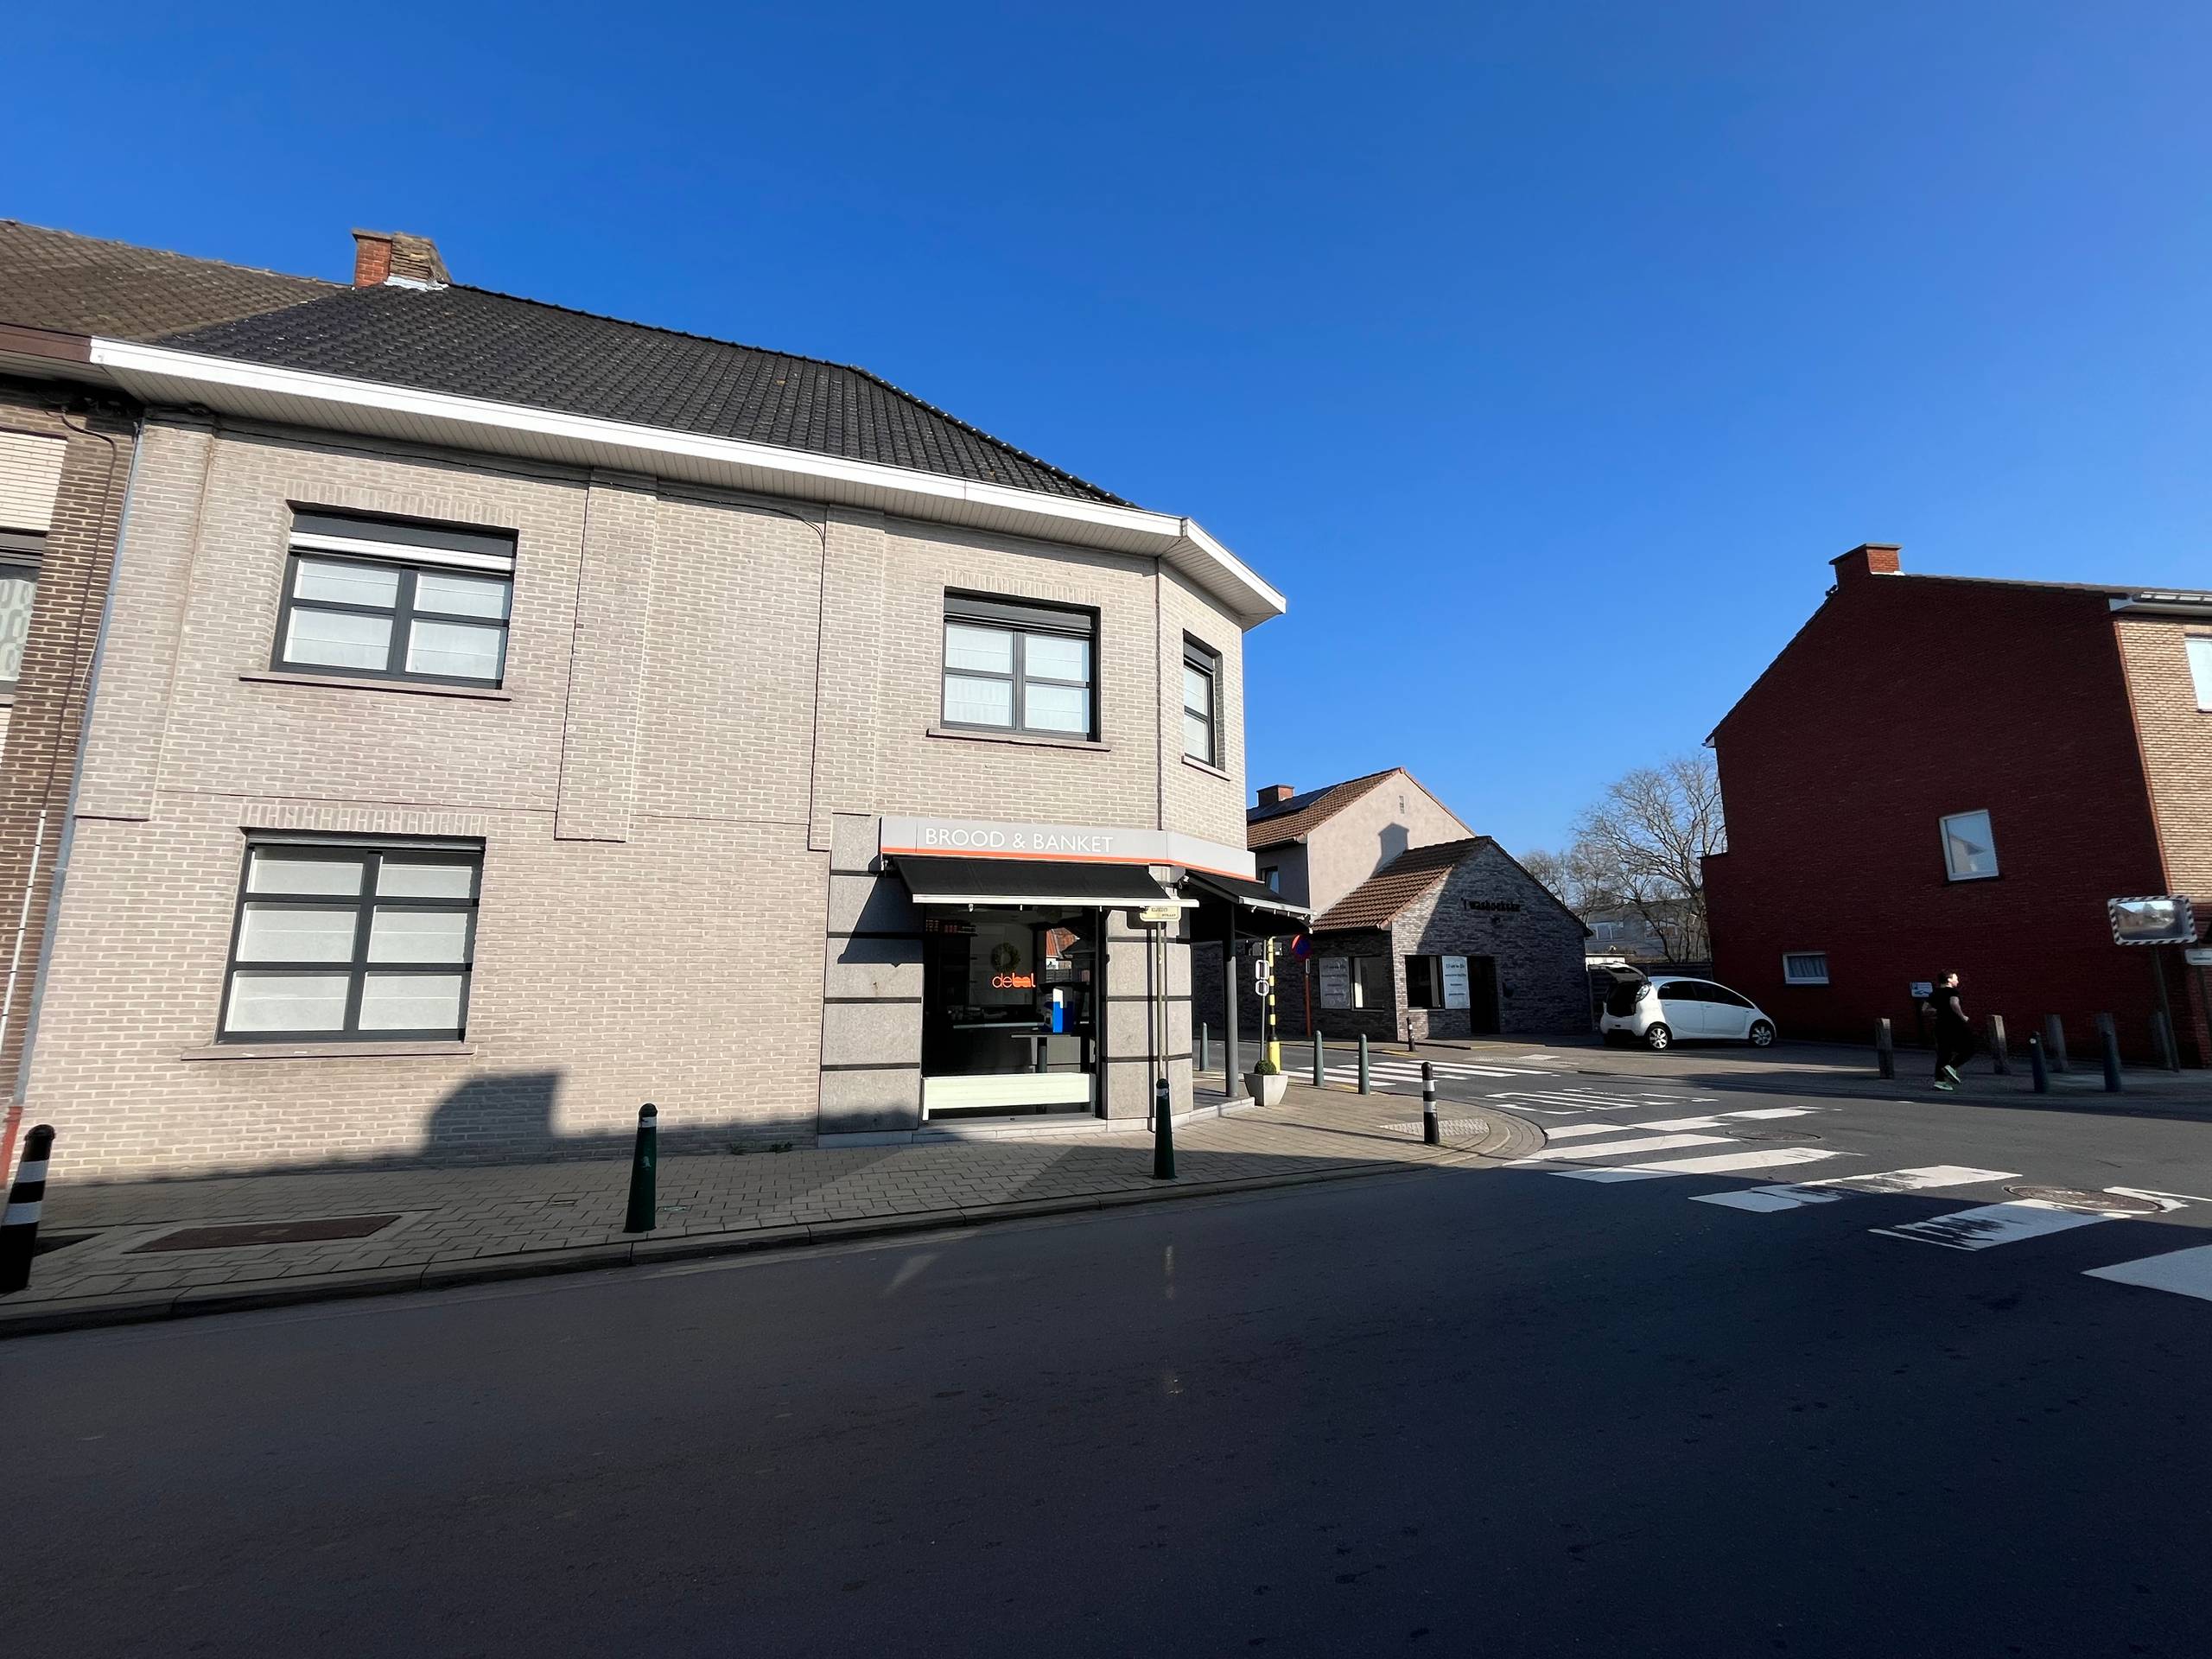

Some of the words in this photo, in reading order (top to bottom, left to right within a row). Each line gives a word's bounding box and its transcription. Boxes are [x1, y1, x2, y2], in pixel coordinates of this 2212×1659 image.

[925, 829, 1005, 848] BROOD
[1012, 833, 1026, 849] &
[1033, 834, 1114, 853] BANKET
